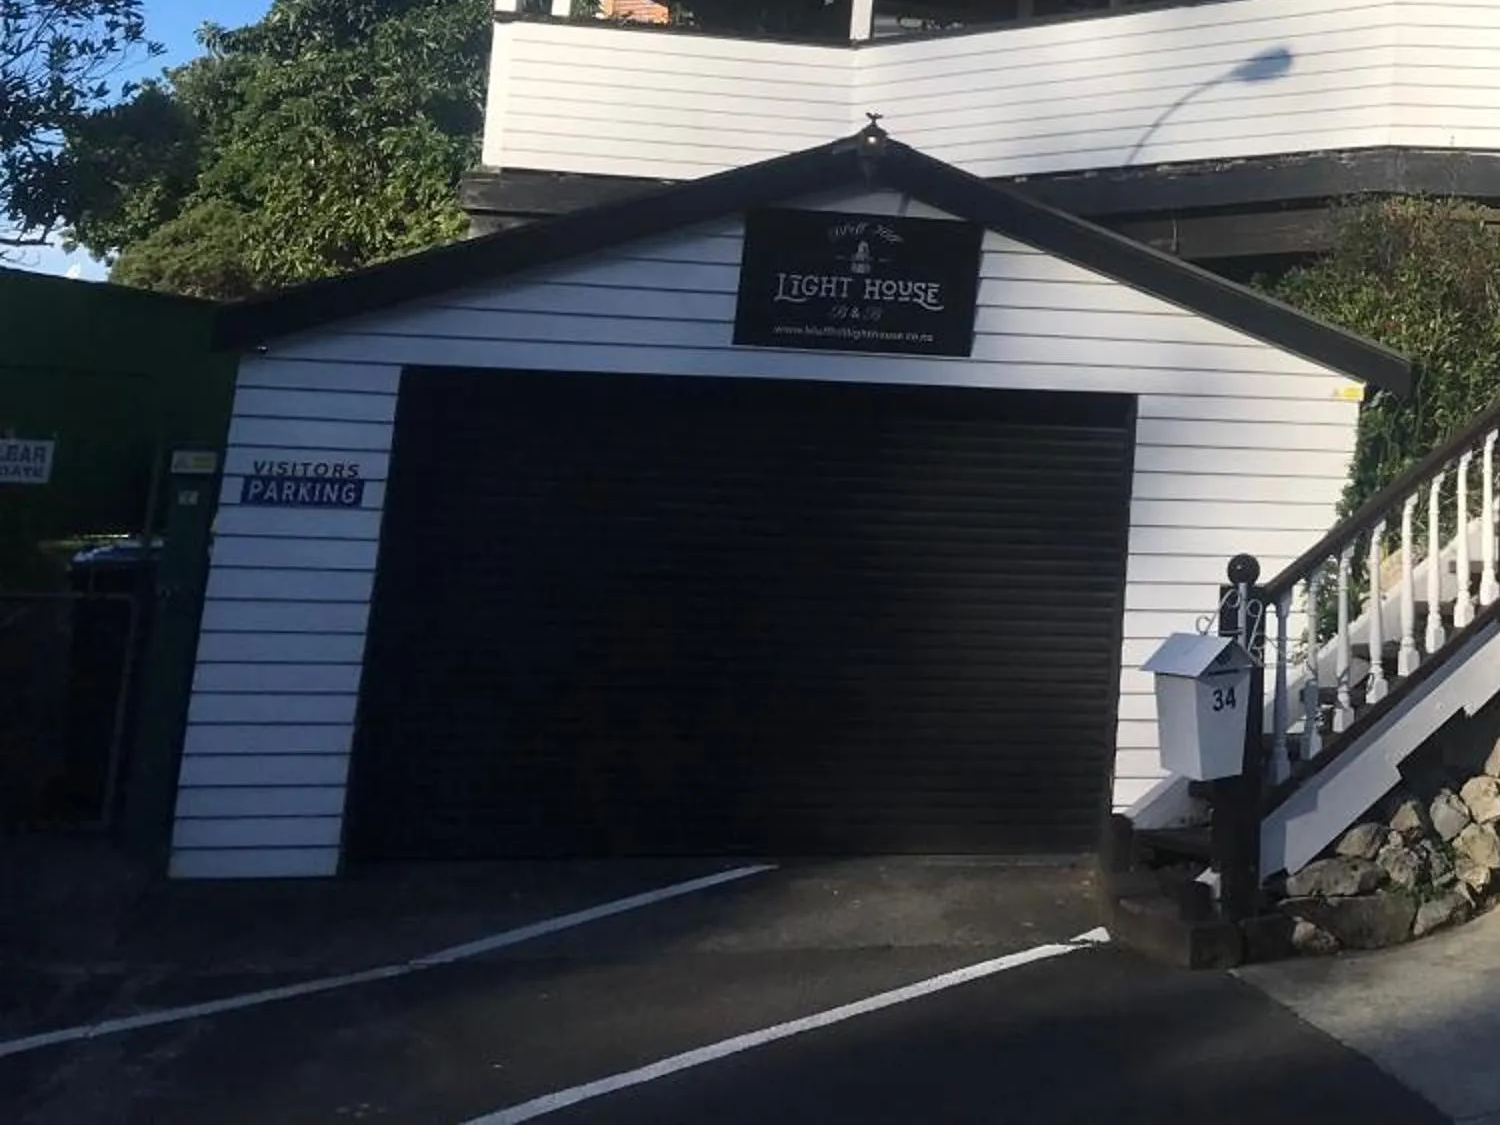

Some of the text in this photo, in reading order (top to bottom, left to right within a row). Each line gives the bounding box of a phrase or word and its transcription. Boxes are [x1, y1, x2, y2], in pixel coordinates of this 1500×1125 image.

[773, 272, 945, 311] LIGHT HOUSE
[252, 459, 361, 478] VISITORS
[247, 481, 357, 505] PARKING
[1212, 686, 1236, 712] 34
